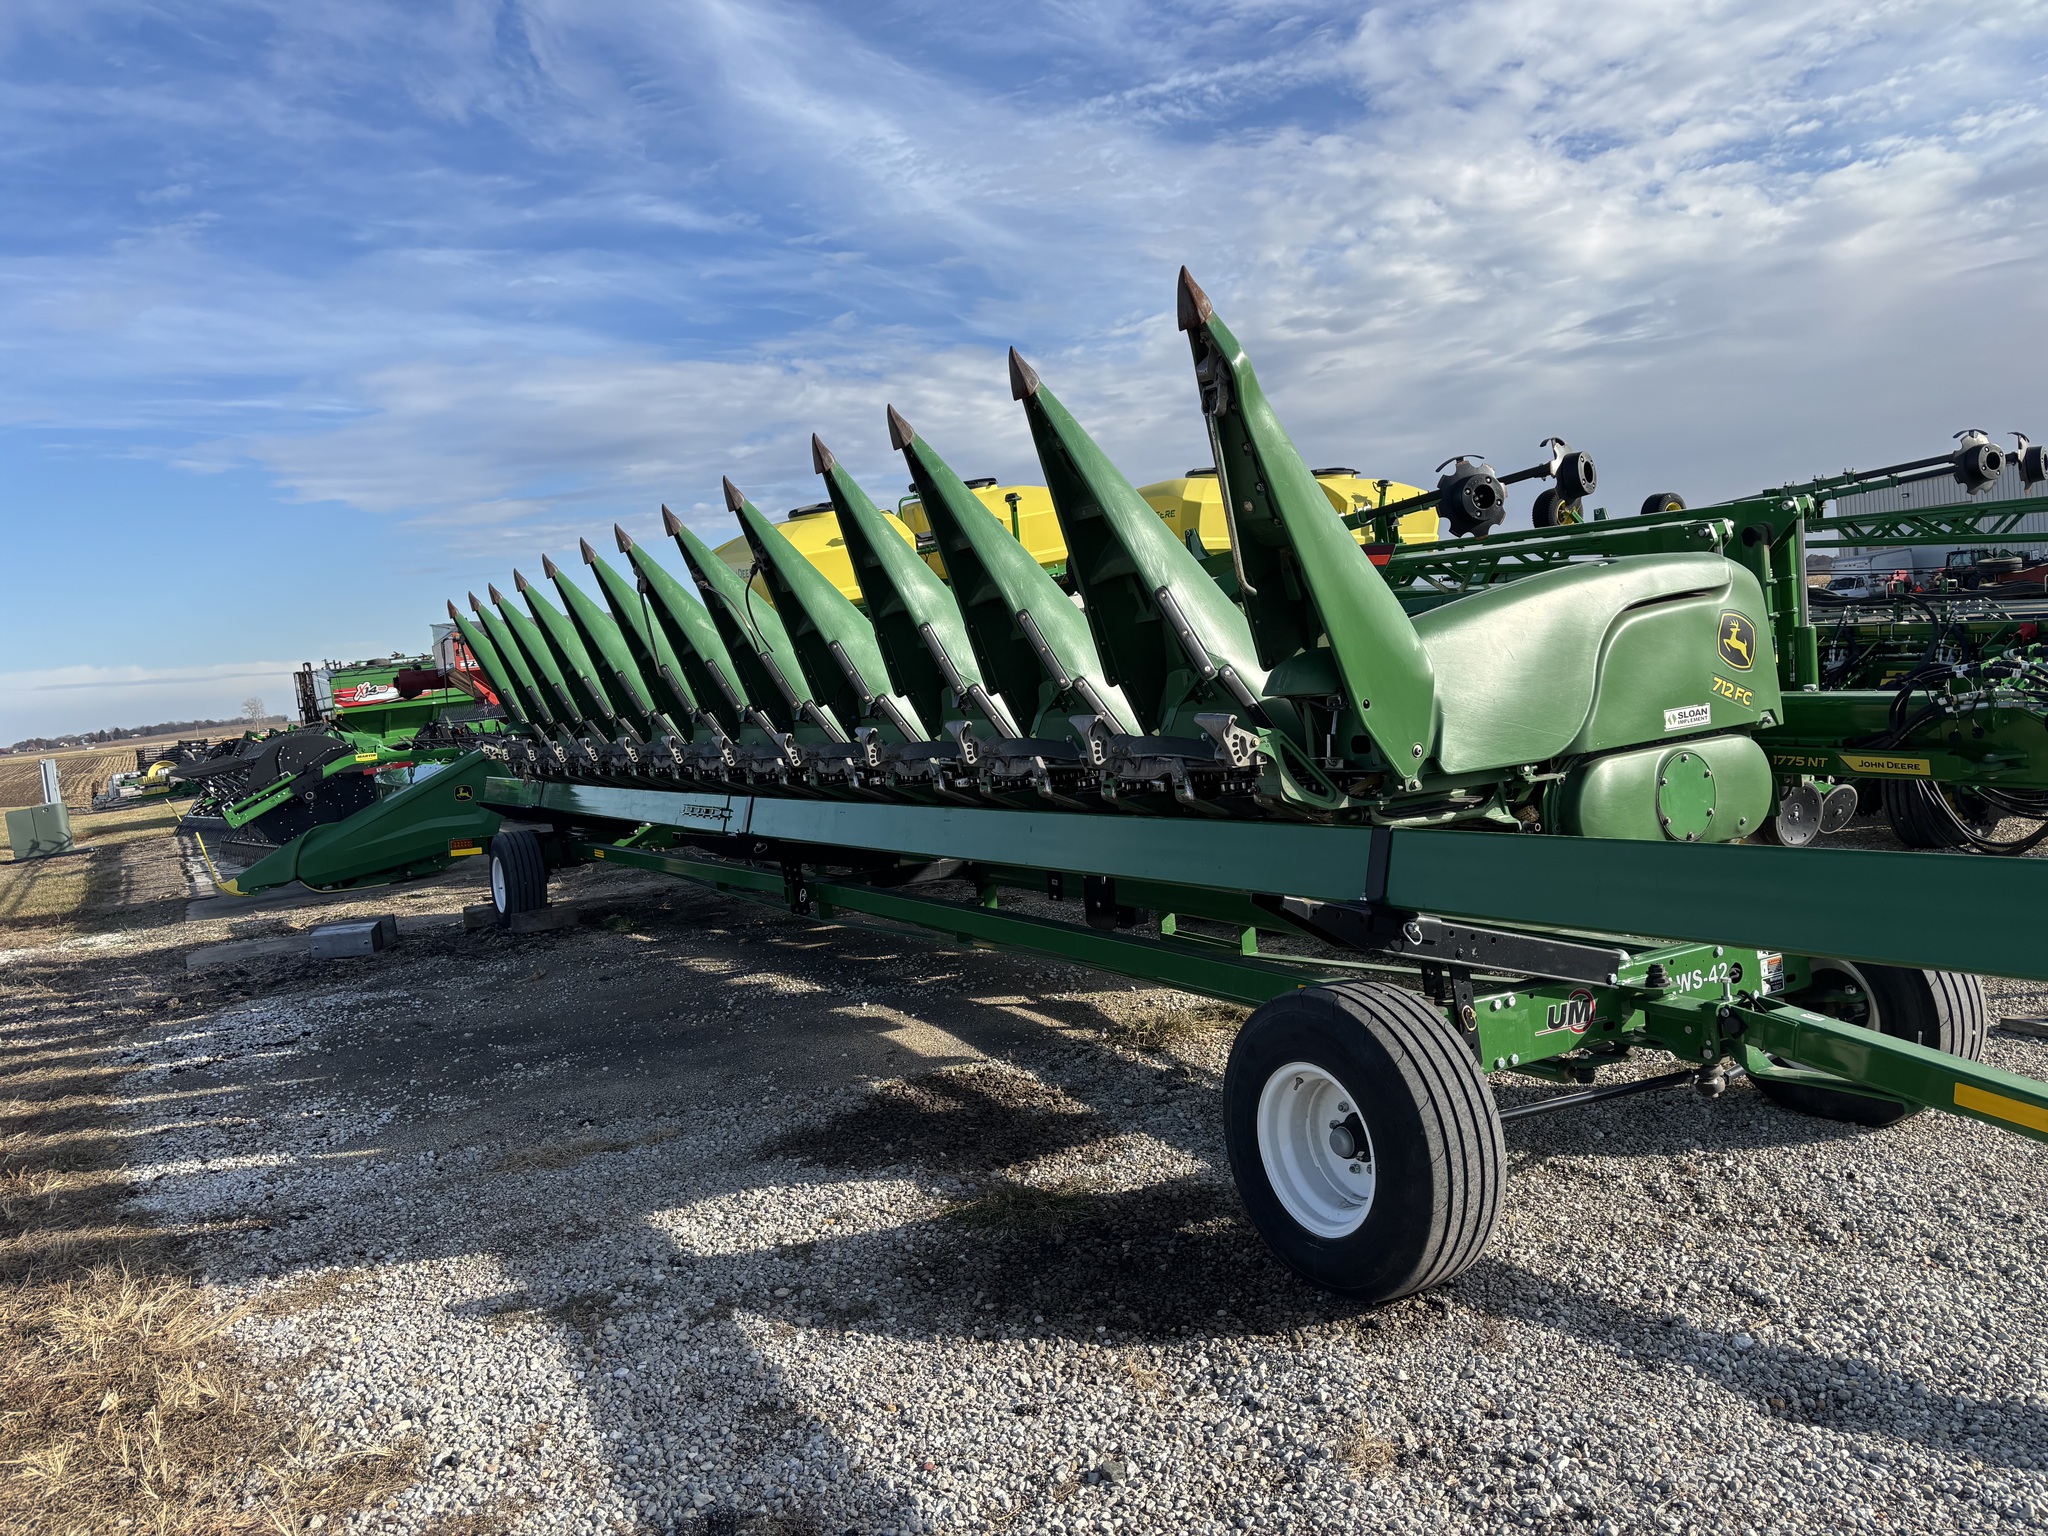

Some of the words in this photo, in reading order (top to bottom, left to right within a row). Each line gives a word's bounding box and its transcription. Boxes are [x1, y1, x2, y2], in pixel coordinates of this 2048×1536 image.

[1712, 676, 1734, 699] 712
[1734, 686, 1753, 706] FC
[1677, 707, 1708, 720] SLOAN
[1677, 715, 1708, 725] IMPLEMENT
[1772, 754, 1805, 767] 1775
[1807, 756, 1829, 768] NT
[1858, 759, 1885, 769] JOHN
[1886, 761, 1921, 771] DEERE
[1668, 962, 1728, 996] WS-42
[1547, 998, 1591, 1030] UM
